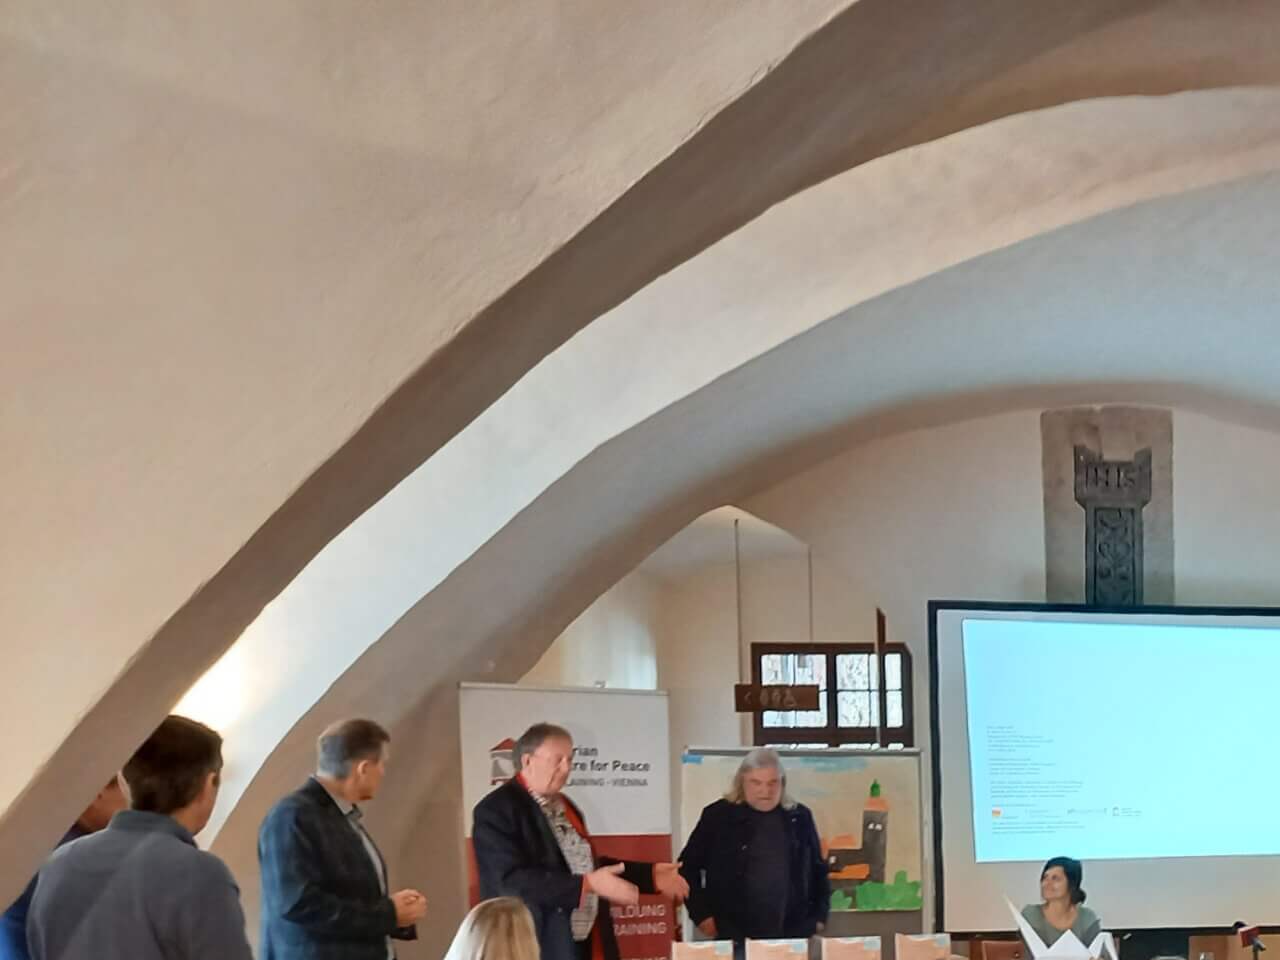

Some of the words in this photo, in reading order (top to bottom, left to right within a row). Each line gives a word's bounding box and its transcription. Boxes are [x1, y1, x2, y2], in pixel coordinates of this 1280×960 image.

[572, 745, 599, 757] rian
[590, 760, 609, 772] for
[612, 760, 651, 772] Peace
